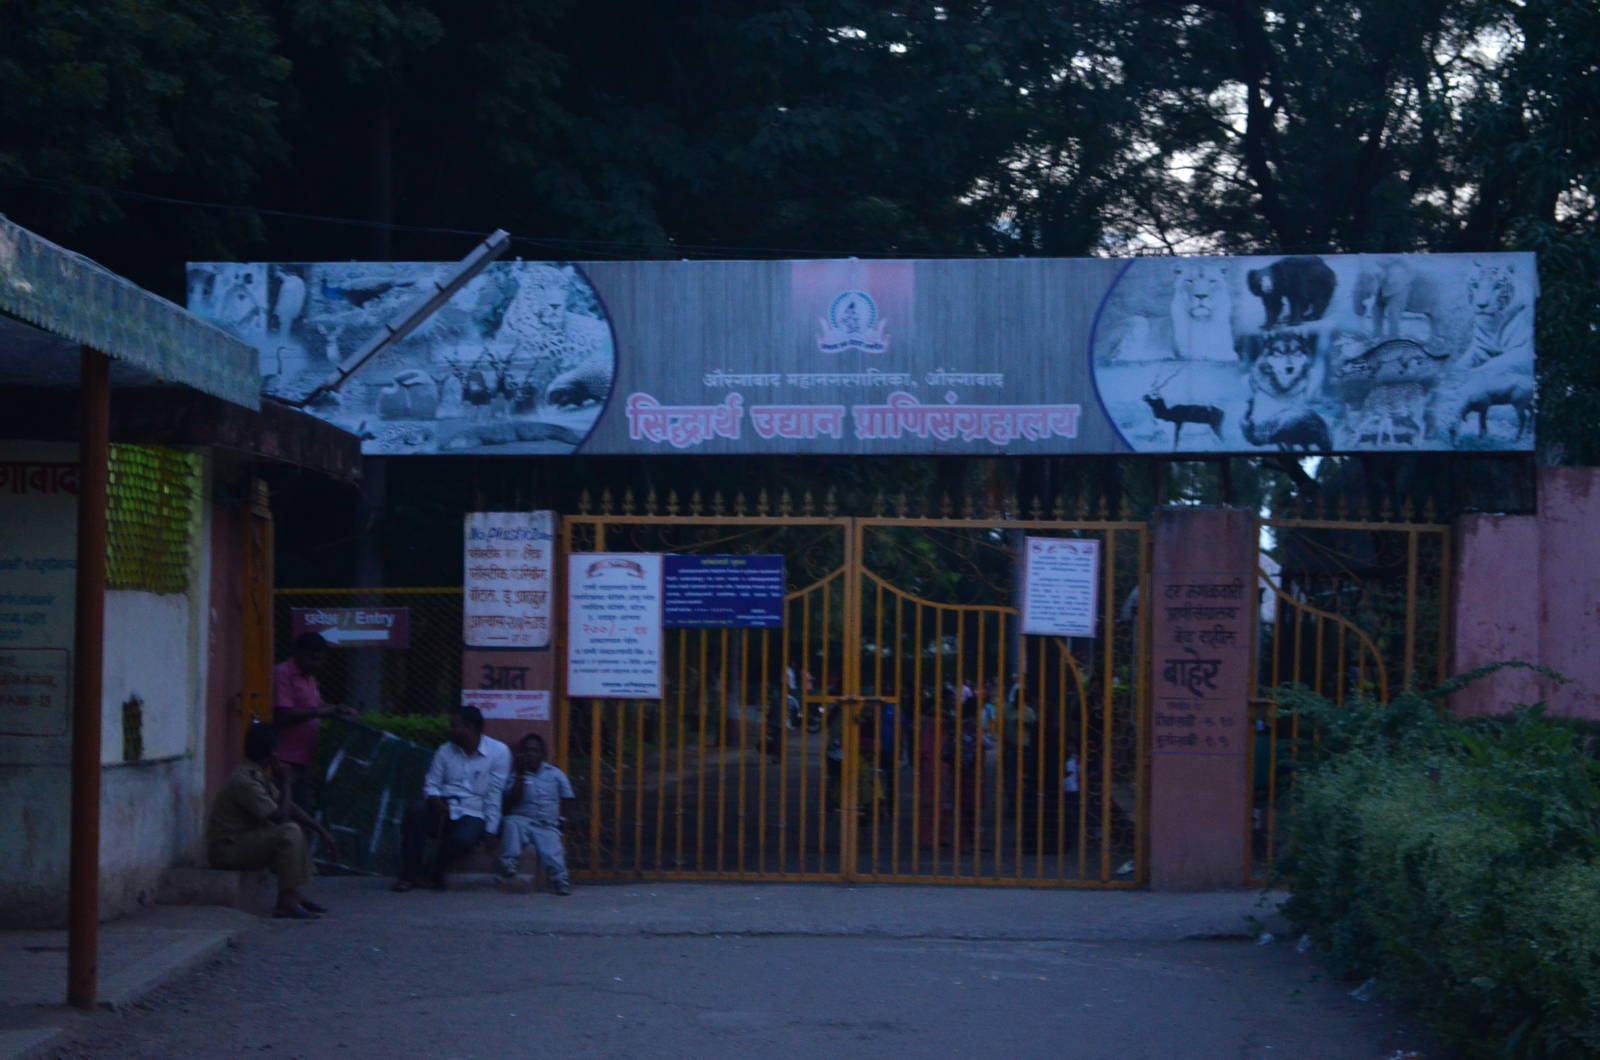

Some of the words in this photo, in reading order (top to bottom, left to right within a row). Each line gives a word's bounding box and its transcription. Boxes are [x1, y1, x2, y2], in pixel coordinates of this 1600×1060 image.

[702, 368, 781, 388] औरंगाबाद
[925, 368, 1004, 388] औरंगाबाद
[626, 391, 744, 448] सिद्धार्थ
[750, 404, 846, 440] उद्यान
[851, 390, 1081, 446] प्राणिसंग्रहालय
[355, 611, 396, 628] Entry
[479, 664, 531, 690] आत
[1163, 647, 1222, 697] बाहेर
